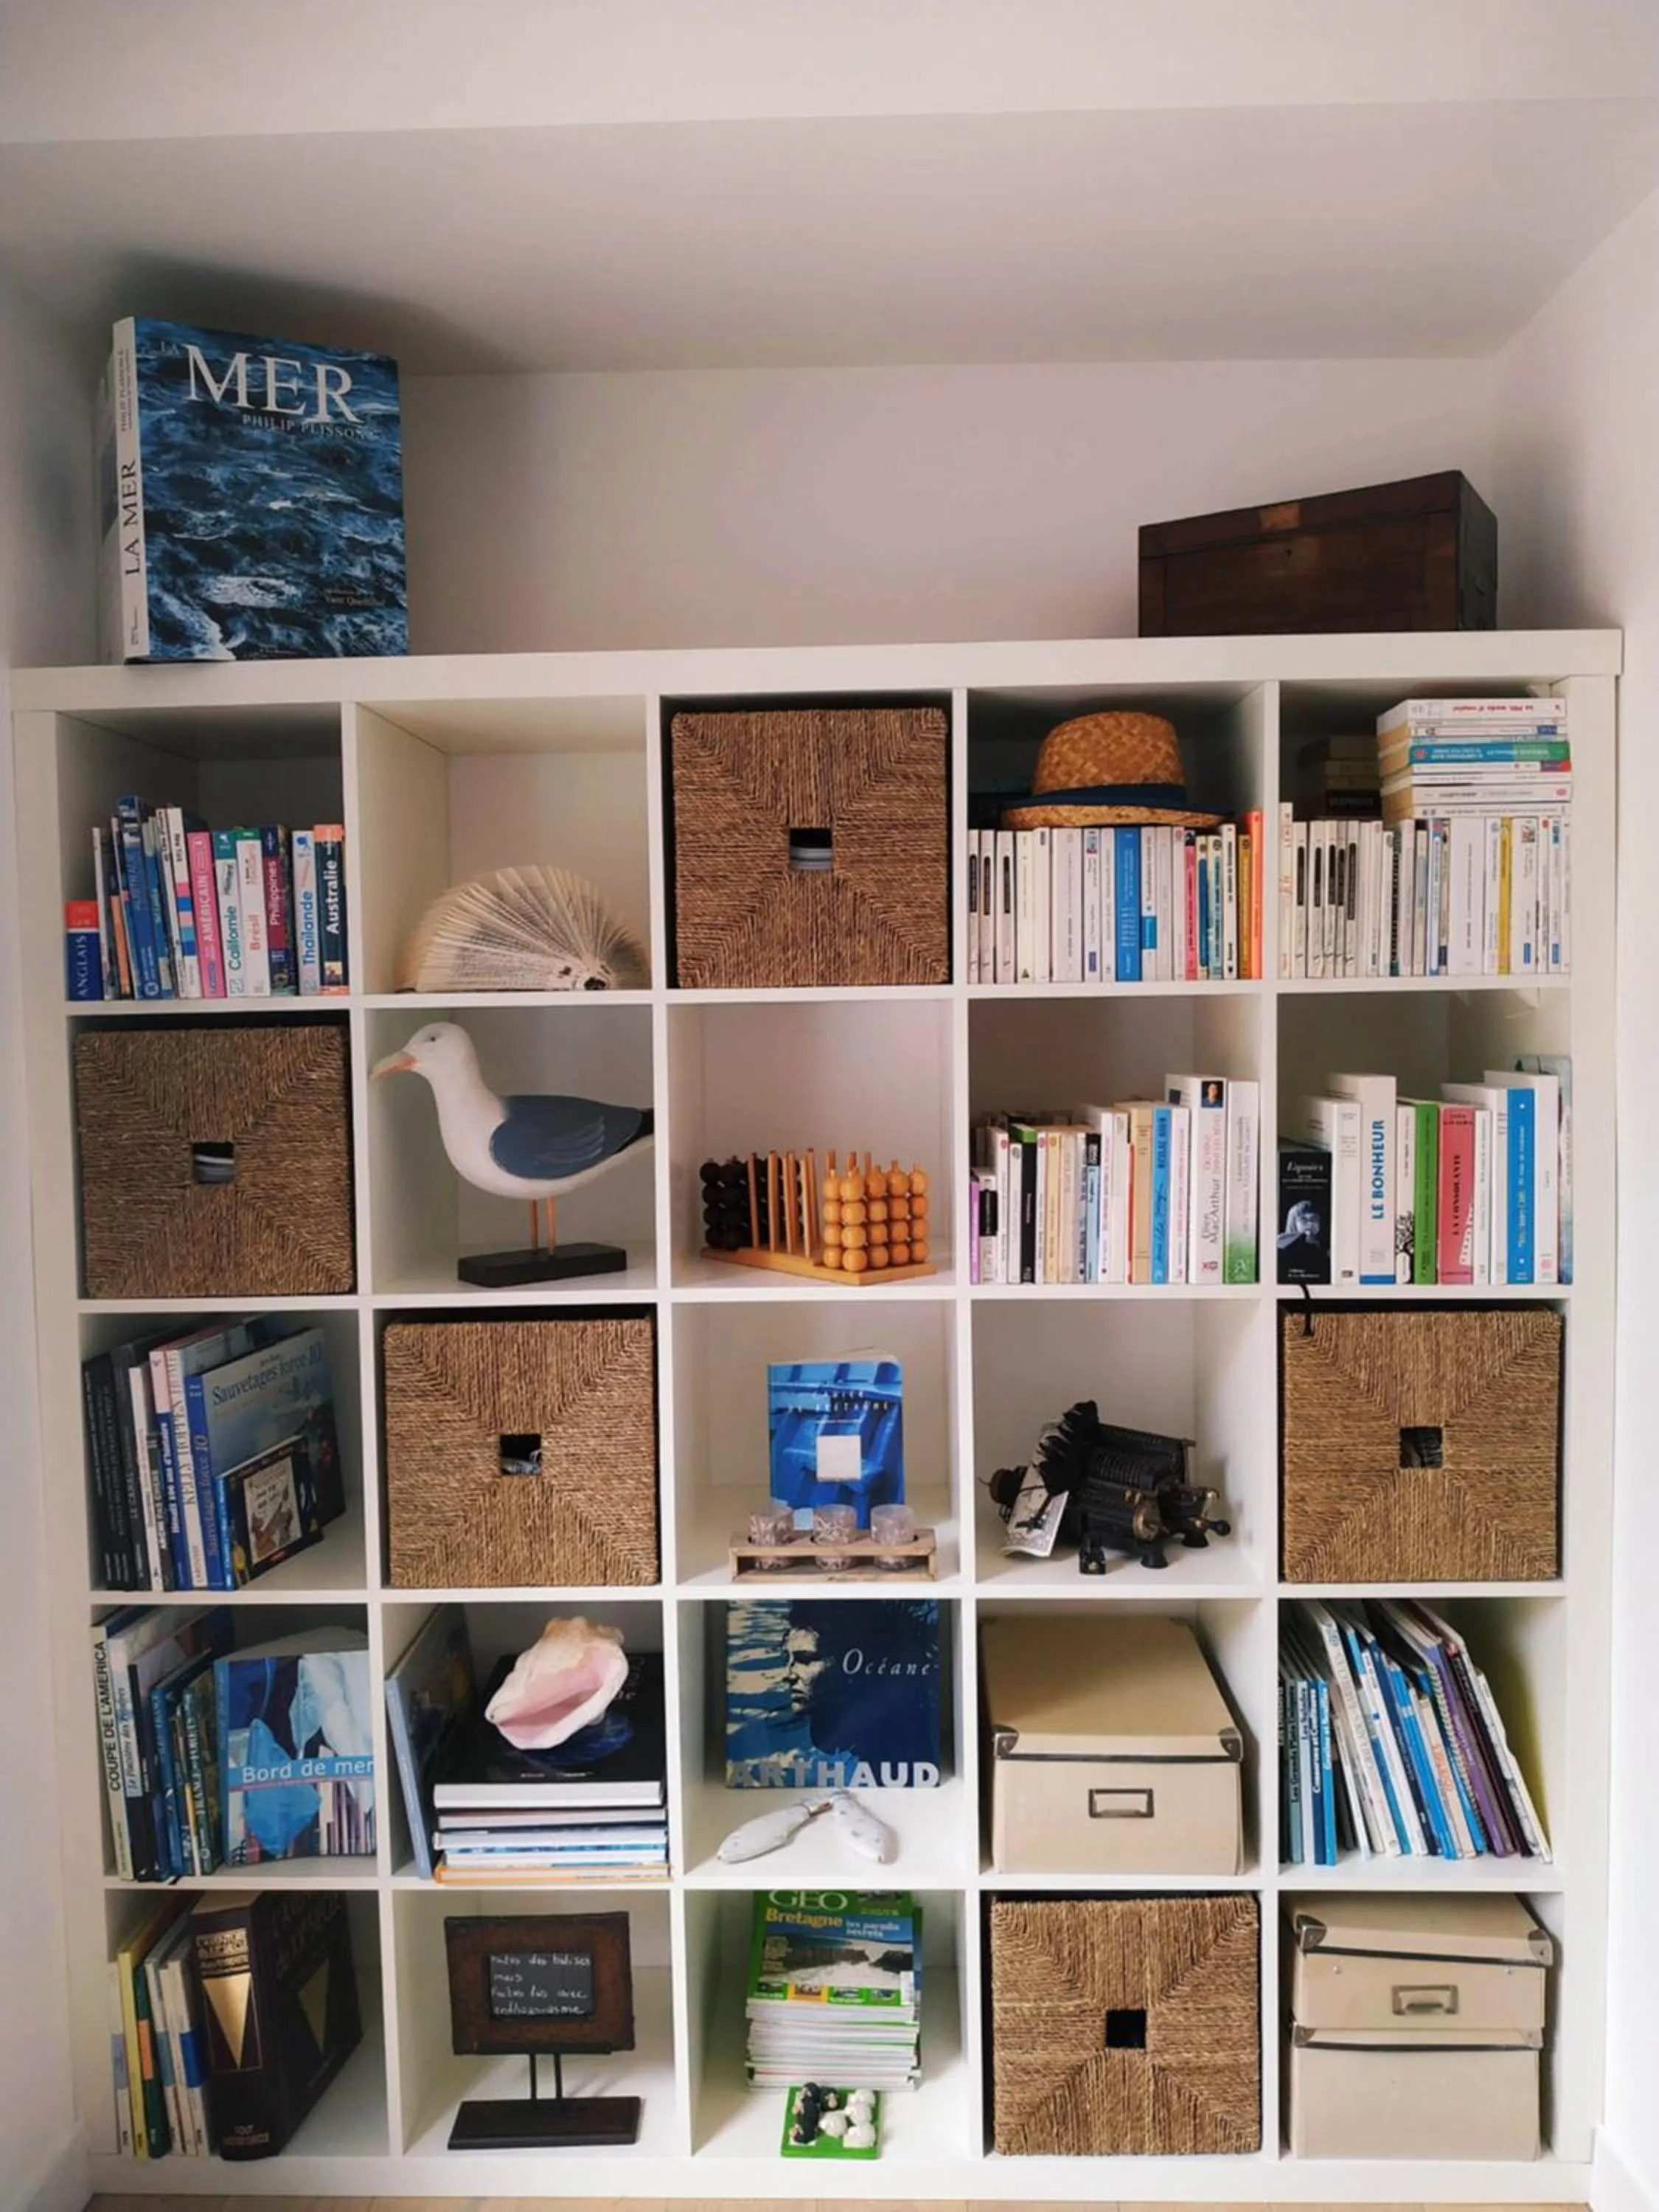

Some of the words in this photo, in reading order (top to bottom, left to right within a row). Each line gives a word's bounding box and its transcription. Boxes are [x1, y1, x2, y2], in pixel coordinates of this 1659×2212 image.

[184, 344, 363, 425] MER
[241, 413, 296, 431] PHILIP
[120, 459, 139, 528] MER
[124, 538, 141, 577] LA
[268, 860, 282, 926] Philippines
[326, 860, 340, 935] Australie
[226, 906, 241, 970] Californie
[74, 935, 88, 997] ANGLAIS
[1372, 1120, 1385, 1192] BONHEUR
[1210, 1178, 1220, 1244] MacArthur
[1372, 1196, 1384, 1220] LE
[212, 1364, 279, 1407] Sauvetages
[94, 1641, 113, 1716] L'AMERICA
[842, 1648, 931, 1676] Océane
[104, 1719, 114, 1739] DE
[105, 1743, 121, 1792] COUPE
[243, 1761, 292, 1784] Bord
[301, 1759, 327, 1777] de
[335, 1759, 375, 1775] mer
[729, 1761, 940, 1788] ARTHAUD
[765, 1907, 844, 1929] Bretagne
[769, 1890, 849, 1911] GEO
